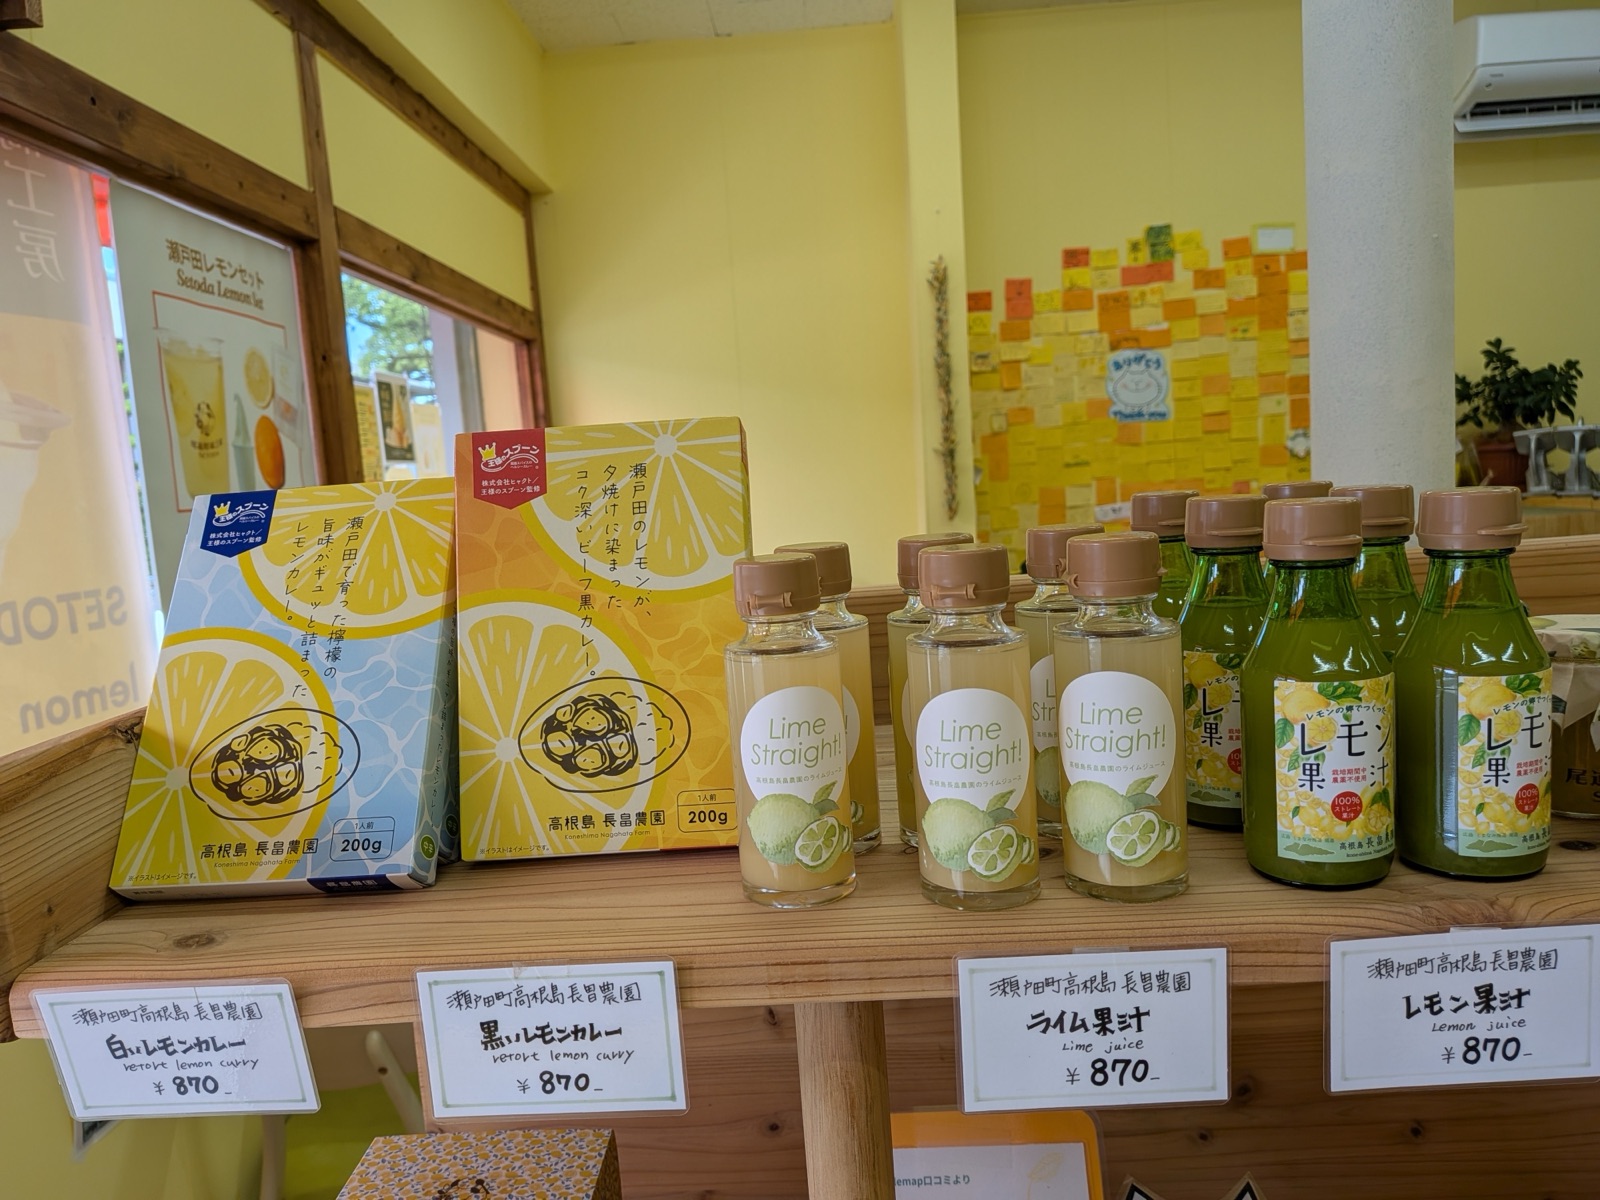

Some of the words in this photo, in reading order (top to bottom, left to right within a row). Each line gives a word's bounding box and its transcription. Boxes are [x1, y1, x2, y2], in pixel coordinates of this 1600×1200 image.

[480, 485, 541, 496] 王様のスプーン監修
[601, 464, 621, 609] 夕焼けに染まった
[629, 462, 651, 617] 瀬戸田のレモンが、
[284, 520, 309, 622] レモンカレー。
[574, 469, 597, 677] コク深いビーフ黒カレー。
[292, 518, 336, 698] 旨味がギュッと詰まった
[323, 516, 364, 679] 瀬戸田で育った檸檬の
[1080, 702, 1143, 725] Lime
[769, 716, 827, 740] Lime
[939, 719, 1002, 743] Lime
[1300, 720, 1391, 757] レモン
[750, 732, 843, 769] Straight!
[1065, 724, 1166, 759] Straight!
[924, 737, 1022, 775] Straight!
[1332, 775, 1367, 784] 農薬不使用
[697, 793, 717, 803] 1人前
[1335, 796, 1361, 805] 100%
[1518, 787, 1538, 799] 100%
[354, 821, 374, 831] 1人前
[548, 814, 596, 832] 高根島
[688, 809, 728, 826] 200g
[200, 842, 249, 860] 高根島
[340, 837, 382, 854] 200g
[1402, 982, 1531, 1020] レモン果汁
[1026, 1006, 1151, 1036] ライム果汁
[1431, 1020, 1477, 1032] Lemon
[1486, 1015, 1527, 1032] juice
[105, 1033, 247, 1060] 白いレモンカレー
[479, 1019, 622, 1051] 黒いレモンカレー
[1104, 1037, 1145, 1054] juice
[123, 1060, 168, 1072] retort
[176, 1059, 213, 1070] lemon
[219, 1058, 260, 1070] curry
[492, 1050, 541, 1064] retort
[550, 1049, 589, 1062] lemon
[596, 1049, 635, 1064] curry
